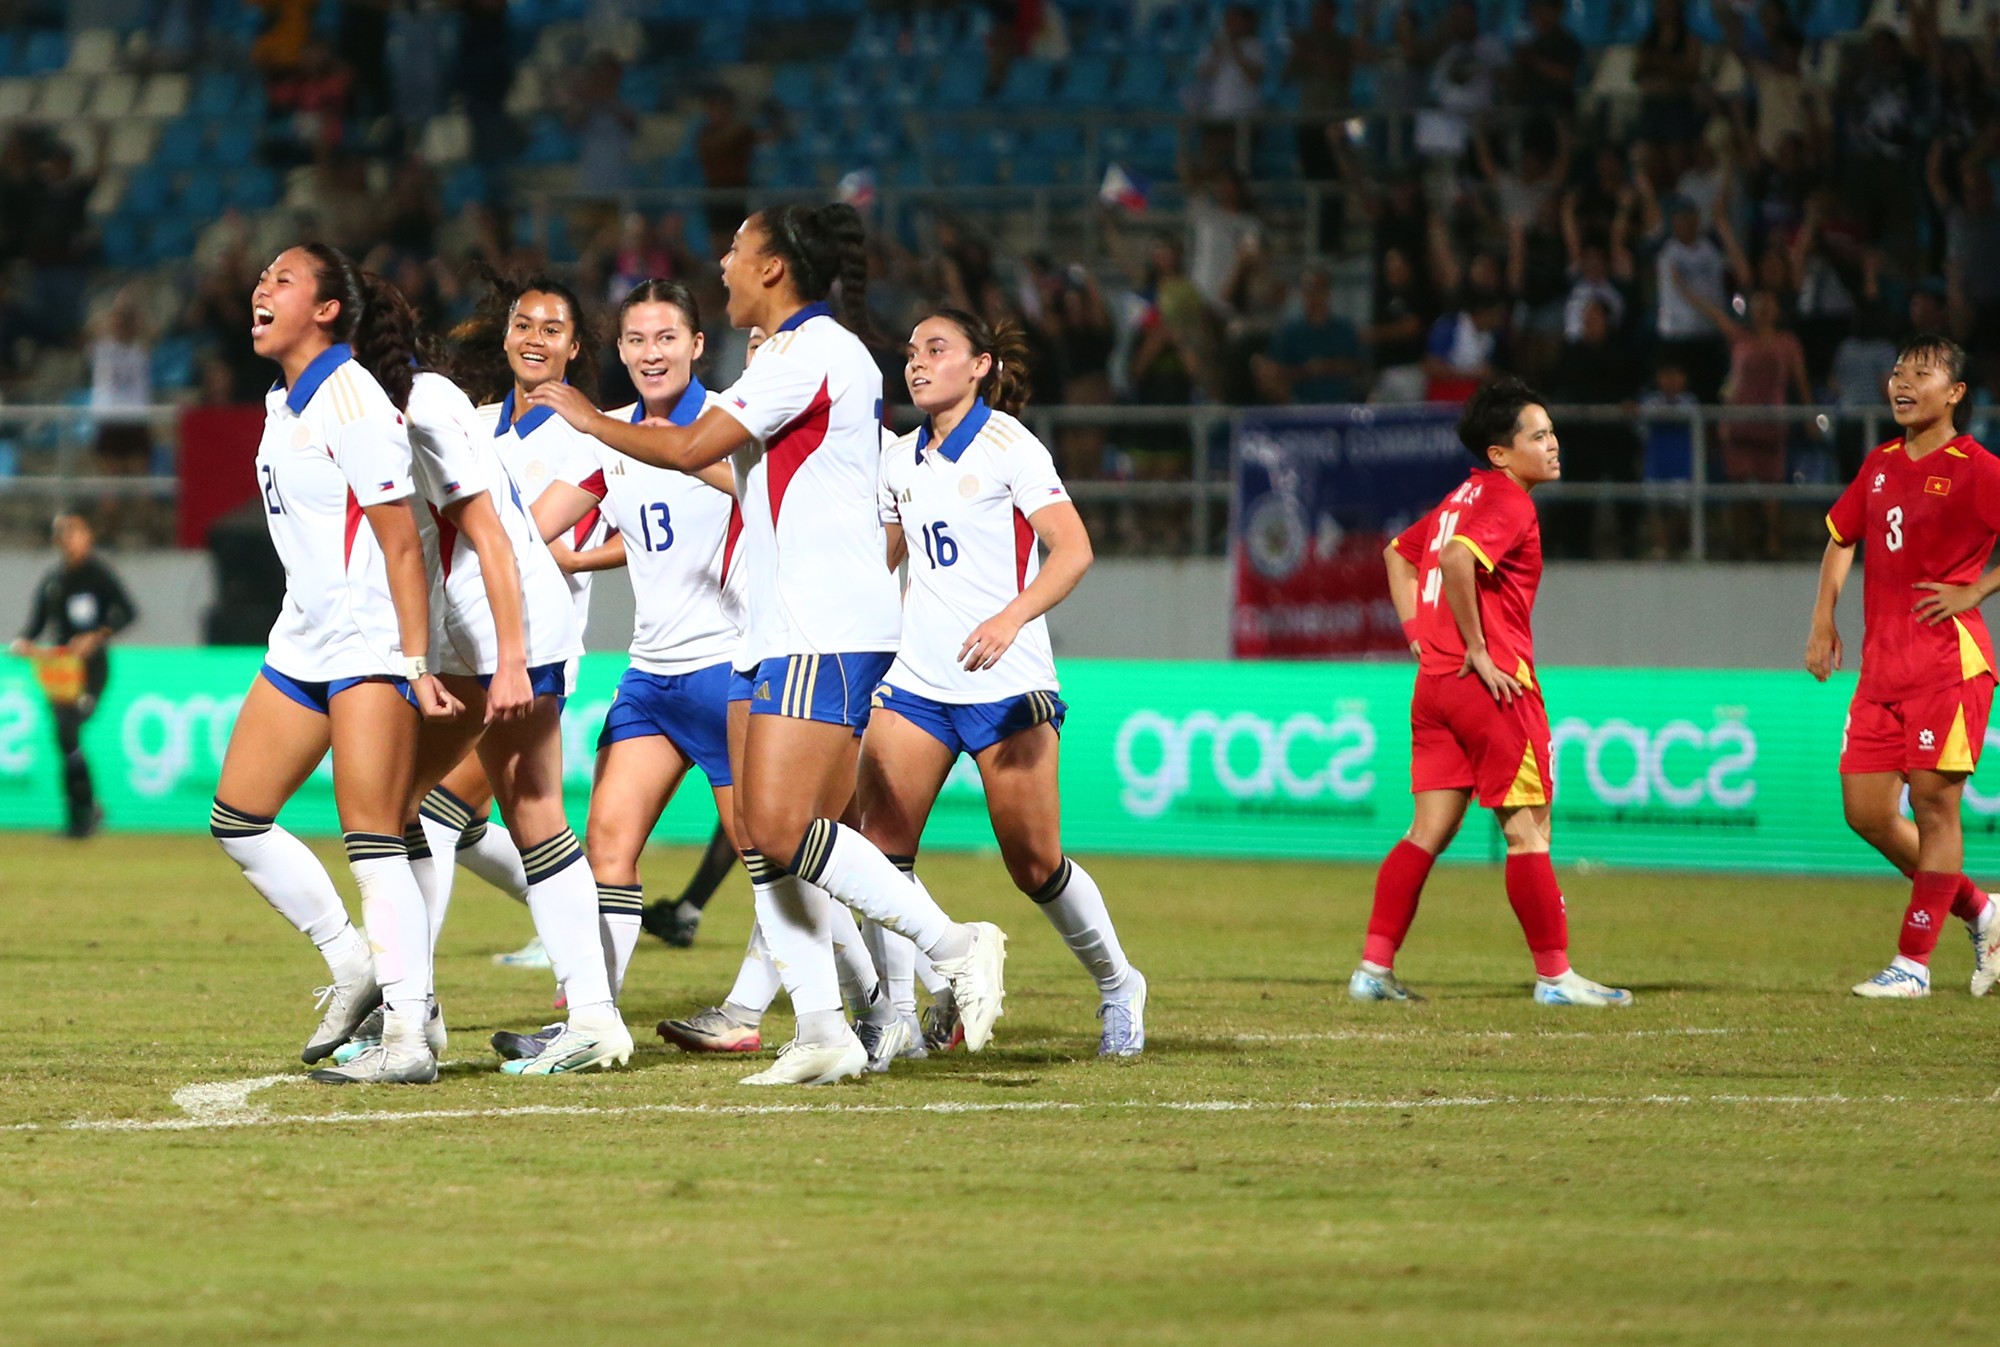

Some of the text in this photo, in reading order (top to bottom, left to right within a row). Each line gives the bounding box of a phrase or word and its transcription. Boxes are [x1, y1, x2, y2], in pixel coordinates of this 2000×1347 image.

[262, 464, 287, 515] 21
[640, 501, 674, 552] 13
[922, 520, 958, 570] 16
[1886, 505, 1903, 552] 3
